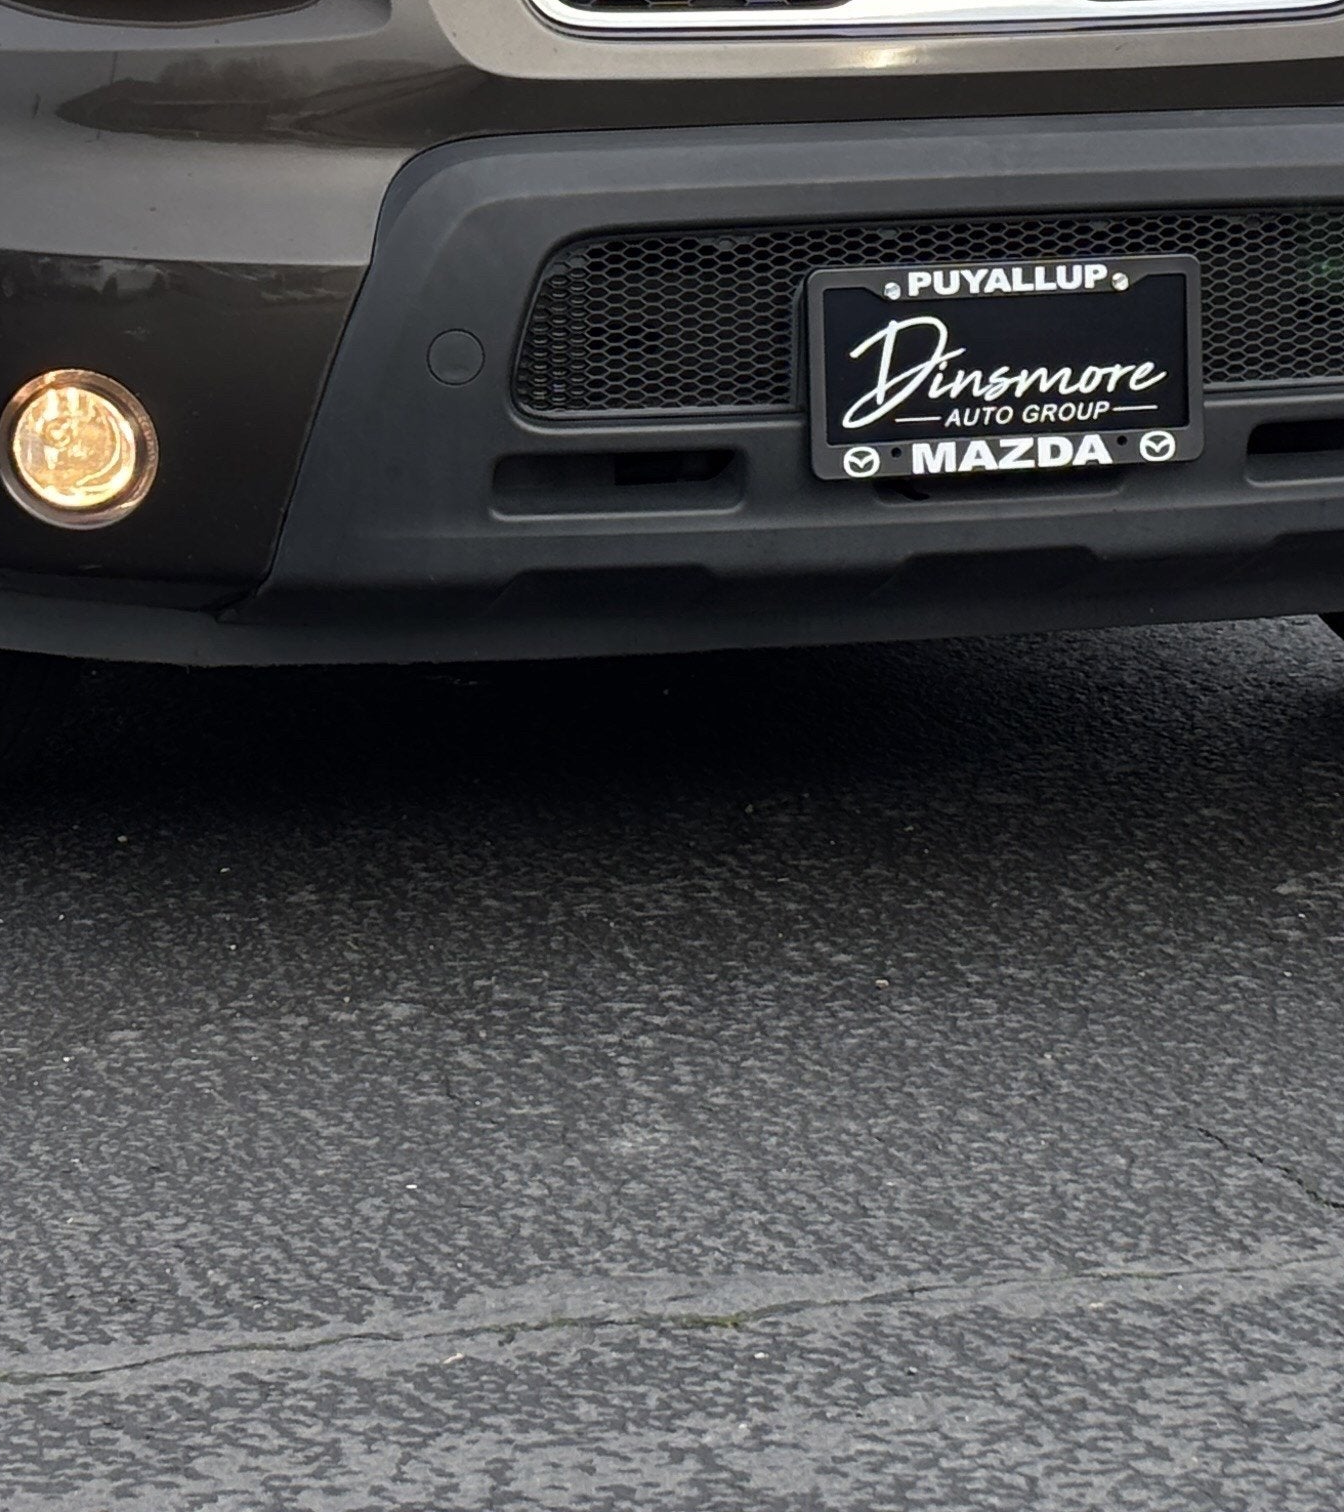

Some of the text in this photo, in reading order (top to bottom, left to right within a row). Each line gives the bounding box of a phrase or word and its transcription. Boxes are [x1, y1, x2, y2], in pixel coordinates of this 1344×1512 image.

[908, 263, 1108, 296] PUYALLUP
[841, 316, 1167, 429] Dinsmore
[945, 400, 1111, 428] AUTO GROUP
[911, 433, 1113, 475] MAZDA
